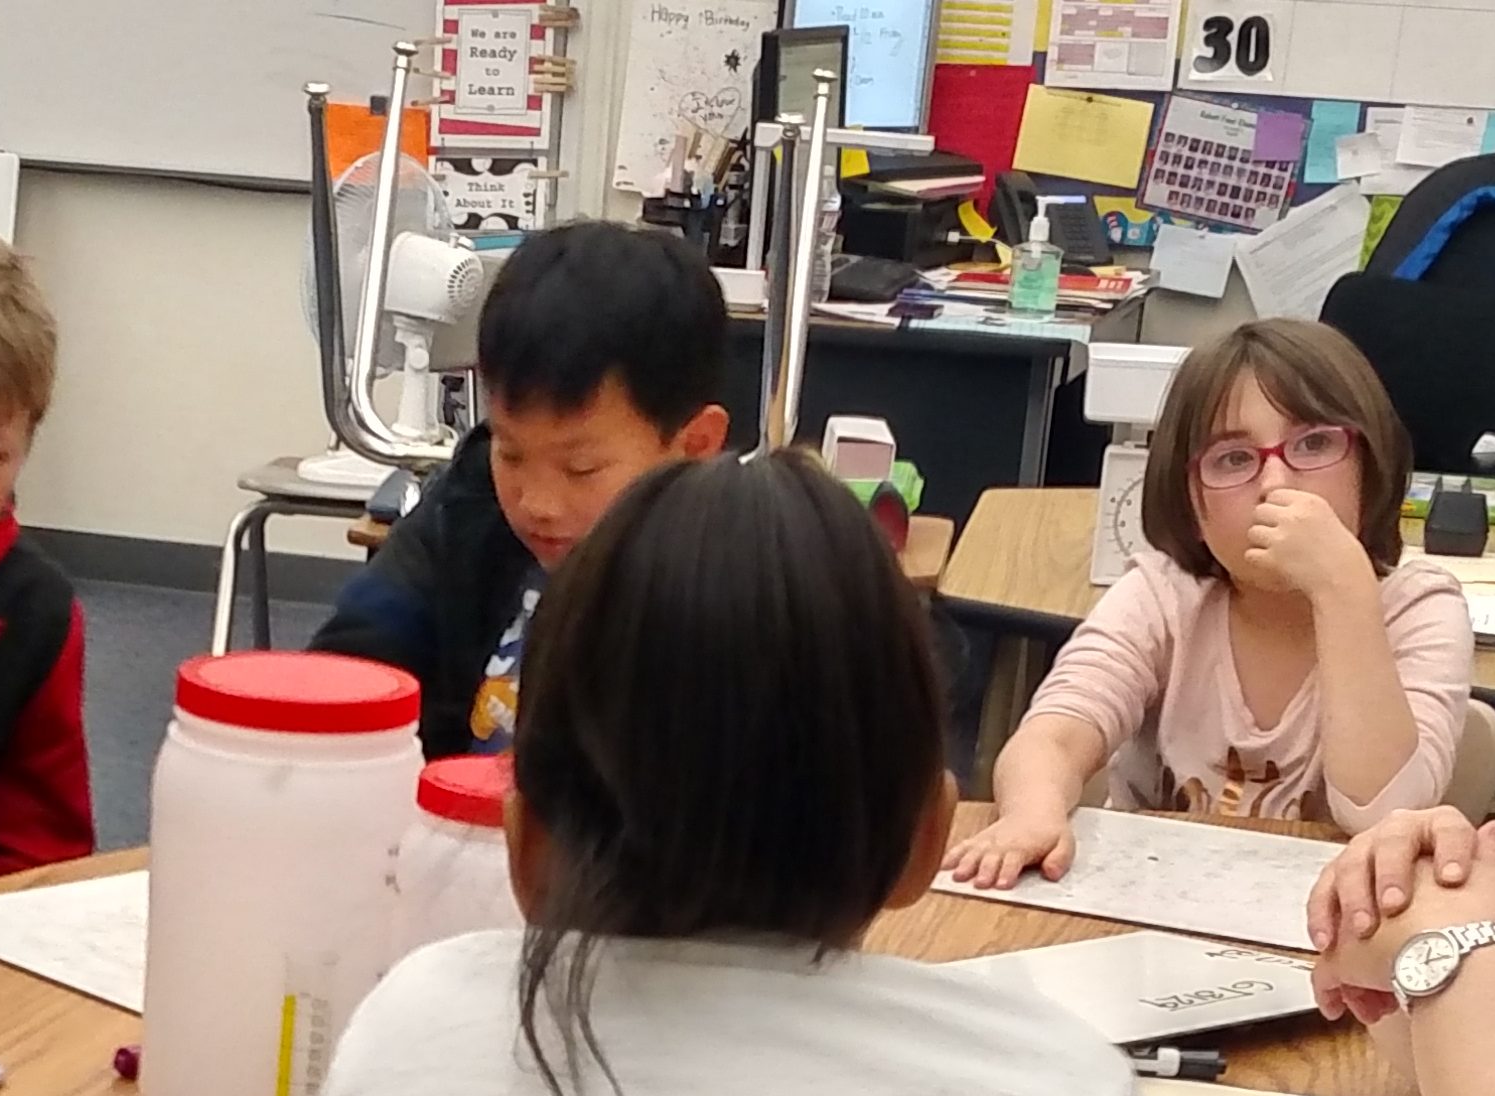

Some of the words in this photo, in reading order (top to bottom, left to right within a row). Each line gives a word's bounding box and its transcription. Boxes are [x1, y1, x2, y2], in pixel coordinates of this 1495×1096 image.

[650, 4, 689, 29] Happy
[471, 29, 486, 39] We
[494, 31, 517, 39] are
[1193, 15, 1270, 76] 30
[470, 46, 518, 62] Ready
[485, 67, 500, 76] to
[468, 84, 515, 96] Learn
[468, 182, 506, 192] Think
[455, 198, 492, 208] About
[501, 199, 515, 208] It
